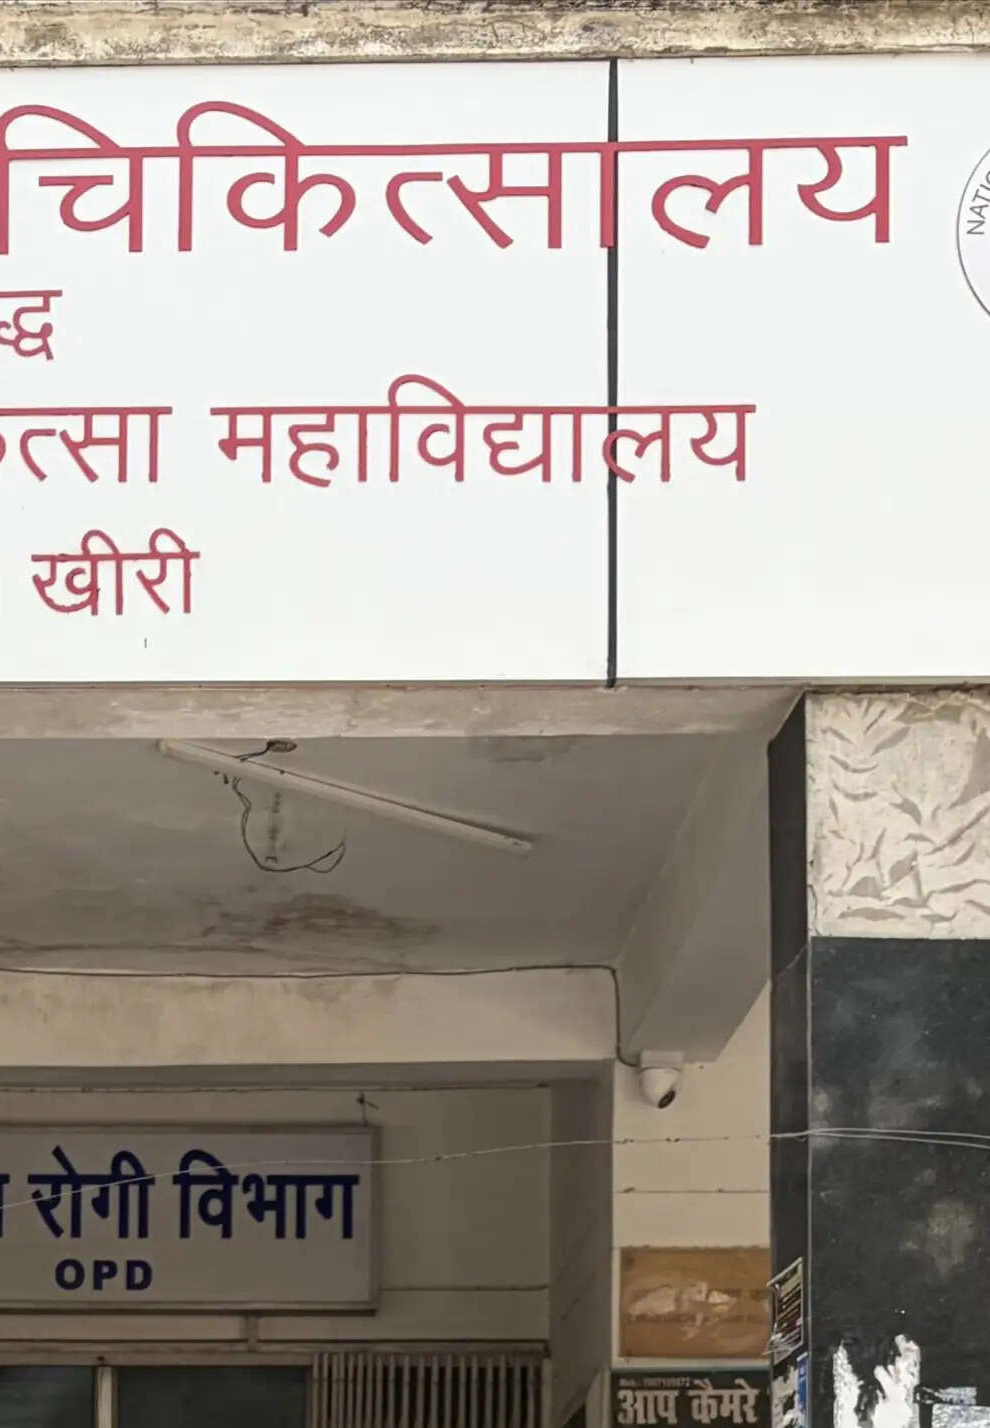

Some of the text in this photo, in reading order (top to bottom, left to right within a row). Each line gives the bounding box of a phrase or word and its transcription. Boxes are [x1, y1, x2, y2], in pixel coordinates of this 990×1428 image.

[210, 374, 756, 487] महाविद्यालय
[31, 528, 200, 616] खीरी
[28, 1146, 155, 1238] रोगी
[173, 1150, 360, 1239] विभाग
[55, 1259, 152, 1290] OPD
[617, 1378, 759, 1424] आप कैमरे
